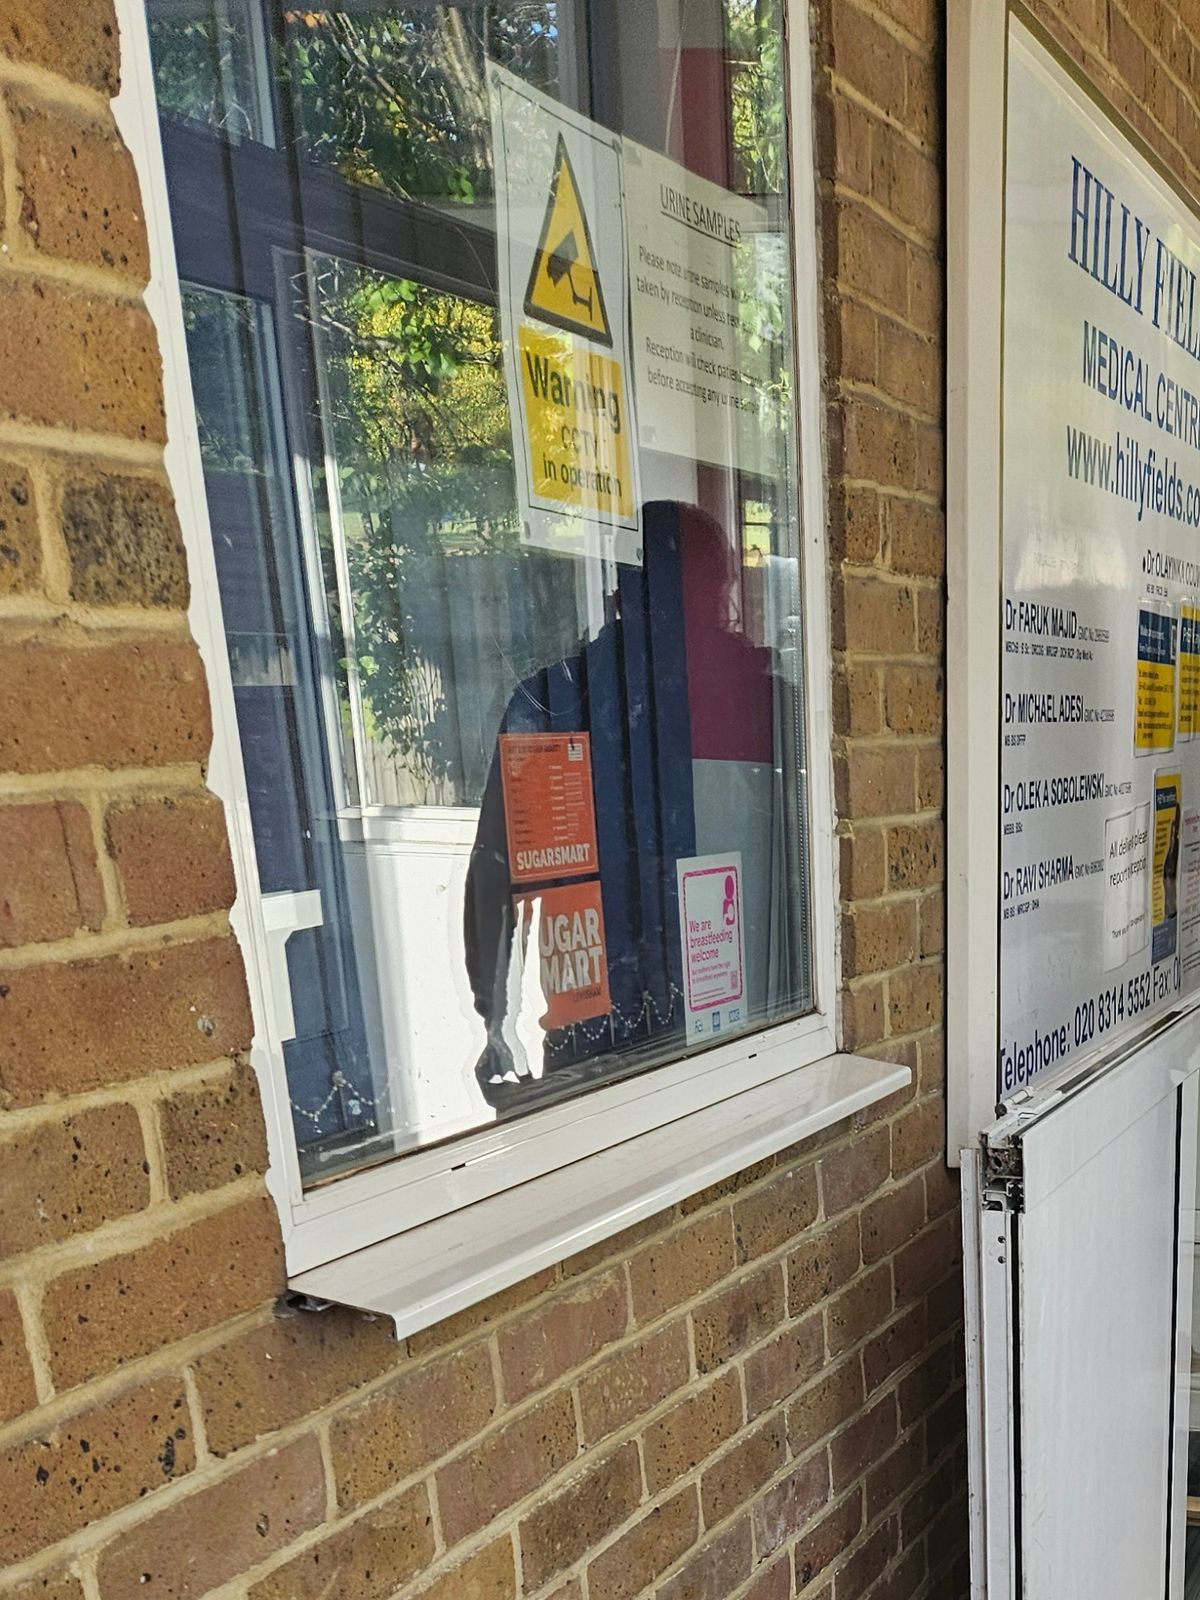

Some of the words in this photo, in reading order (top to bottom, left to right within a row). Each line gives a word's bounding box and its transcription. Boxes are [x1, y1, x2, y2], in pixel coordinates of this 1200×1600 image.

[660, 182, 690, 222] URINE
[692, 201, 741, 243] SAMPLES
[1068, 155, 1150, 315] HILLY
[640, 244, 664, 271] Please
[701, 275, 729, 297] samples
[637, 275, 659, 297] taken
[661, 281, 670, 305] by
[703, 304, 726, 322] unless
[646, 336, 682, 363] Reception
[697, 355, 716, 375] check
[647, 365, 674, 389] before
[1083, 320, 1152, 422] MEDICAL
[526, 351, 620, 435] Warning
[561, 425, 599, 458] CCTV
[543, 453, 557, 480] in
[561, 463, 622, 497] operation
[1006, 599, 1016, 630] Dr
[1019, 602, 1049, 635] FARUK
[1052, 608, 1077, 639] MAJID
[1005, 693, 1016, 723] Dr
[1018, 694, 1057, 723] MICHAEL
[1058, 694, 1084, 723] ADESI
[1005, 784, 1015, 813] Dr
[1017, 781, 1041, 811] OLEK
[1043, 779, 1049, 808] A
[1051, 773, 1104, 806] SOBOLEWSKI
[517, 843, 590, 870] SUGARSMART
[1004, 872, 1014, 900] Dr
[1016, 864, 1036, 896] RAVI
[1038, 855, 1074, 890] SHARMA
[538, 908, 601, 957] UGAR
[689, 920, 700, 934] We
[701, 920, 712, 931] are
[690, 930, 733, 949] breastfeeding
[540, 945, 603, 995] MART
[691, 948, 719, 963] welcome
[1000, 1023, 1071, 1094] Telephone:
[1075, 999, 1094, 1047] 020
[1099, 984, 1124, 1033] 8314
[1127, 971, 1150, 1017] 5552
[1153, 965, 1171, 1003] Fax:
